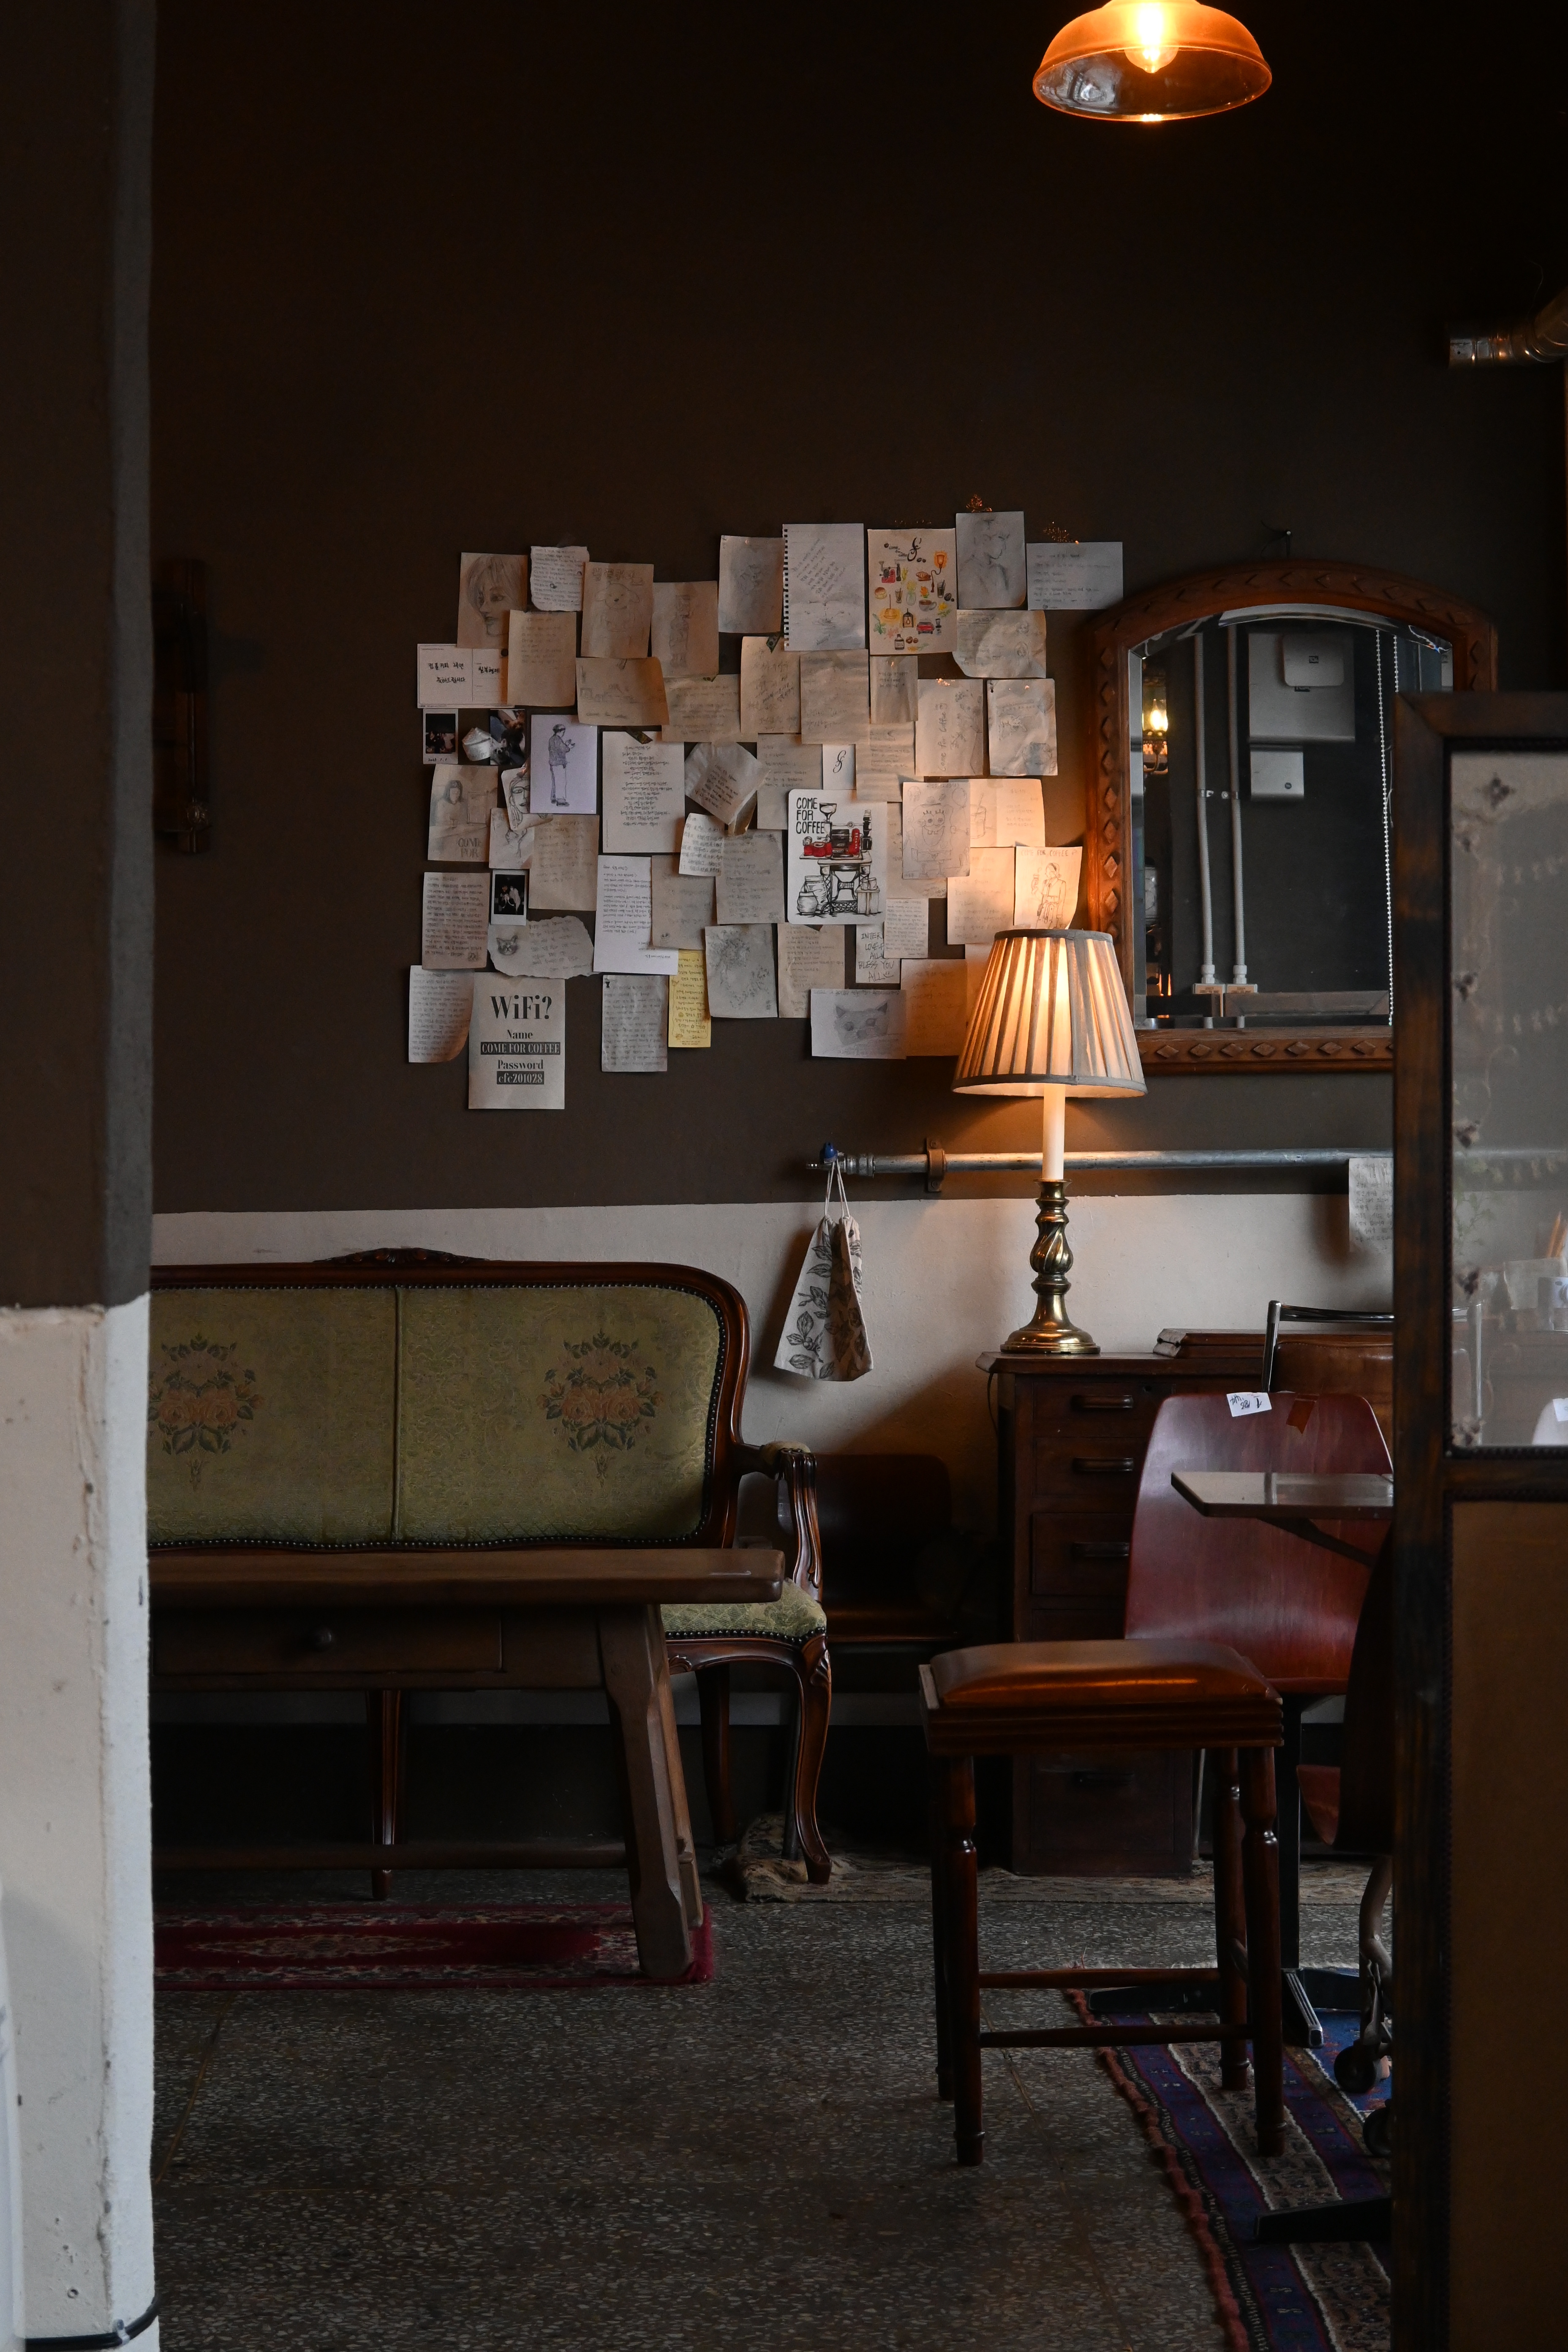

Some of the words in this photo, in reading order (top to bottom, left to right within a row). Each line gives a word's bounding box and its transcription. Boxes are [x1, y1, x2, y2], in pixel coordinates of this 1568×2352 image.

[796, 798, 817, 809] COME
[797, 810, 813, 821] FOR
[796, 821, 825, 834] COFFEE
[858, 961, 878, 969] BLESS
[881, 960, 894, 969] YOU
[868, 971, 885, 982] ALL
[490, 995, 552, 1019] WiFi?
[507, 1029, 533, 1039] Name
[482, 1043, 507, 1053] COME
[509, 1043, 526, 1053] FOR
[528, 1043, 560, 1054] COFFEE
[498, 1059, 543, 1069] Password
[498, 1073, 543, 1083] cfc201028
